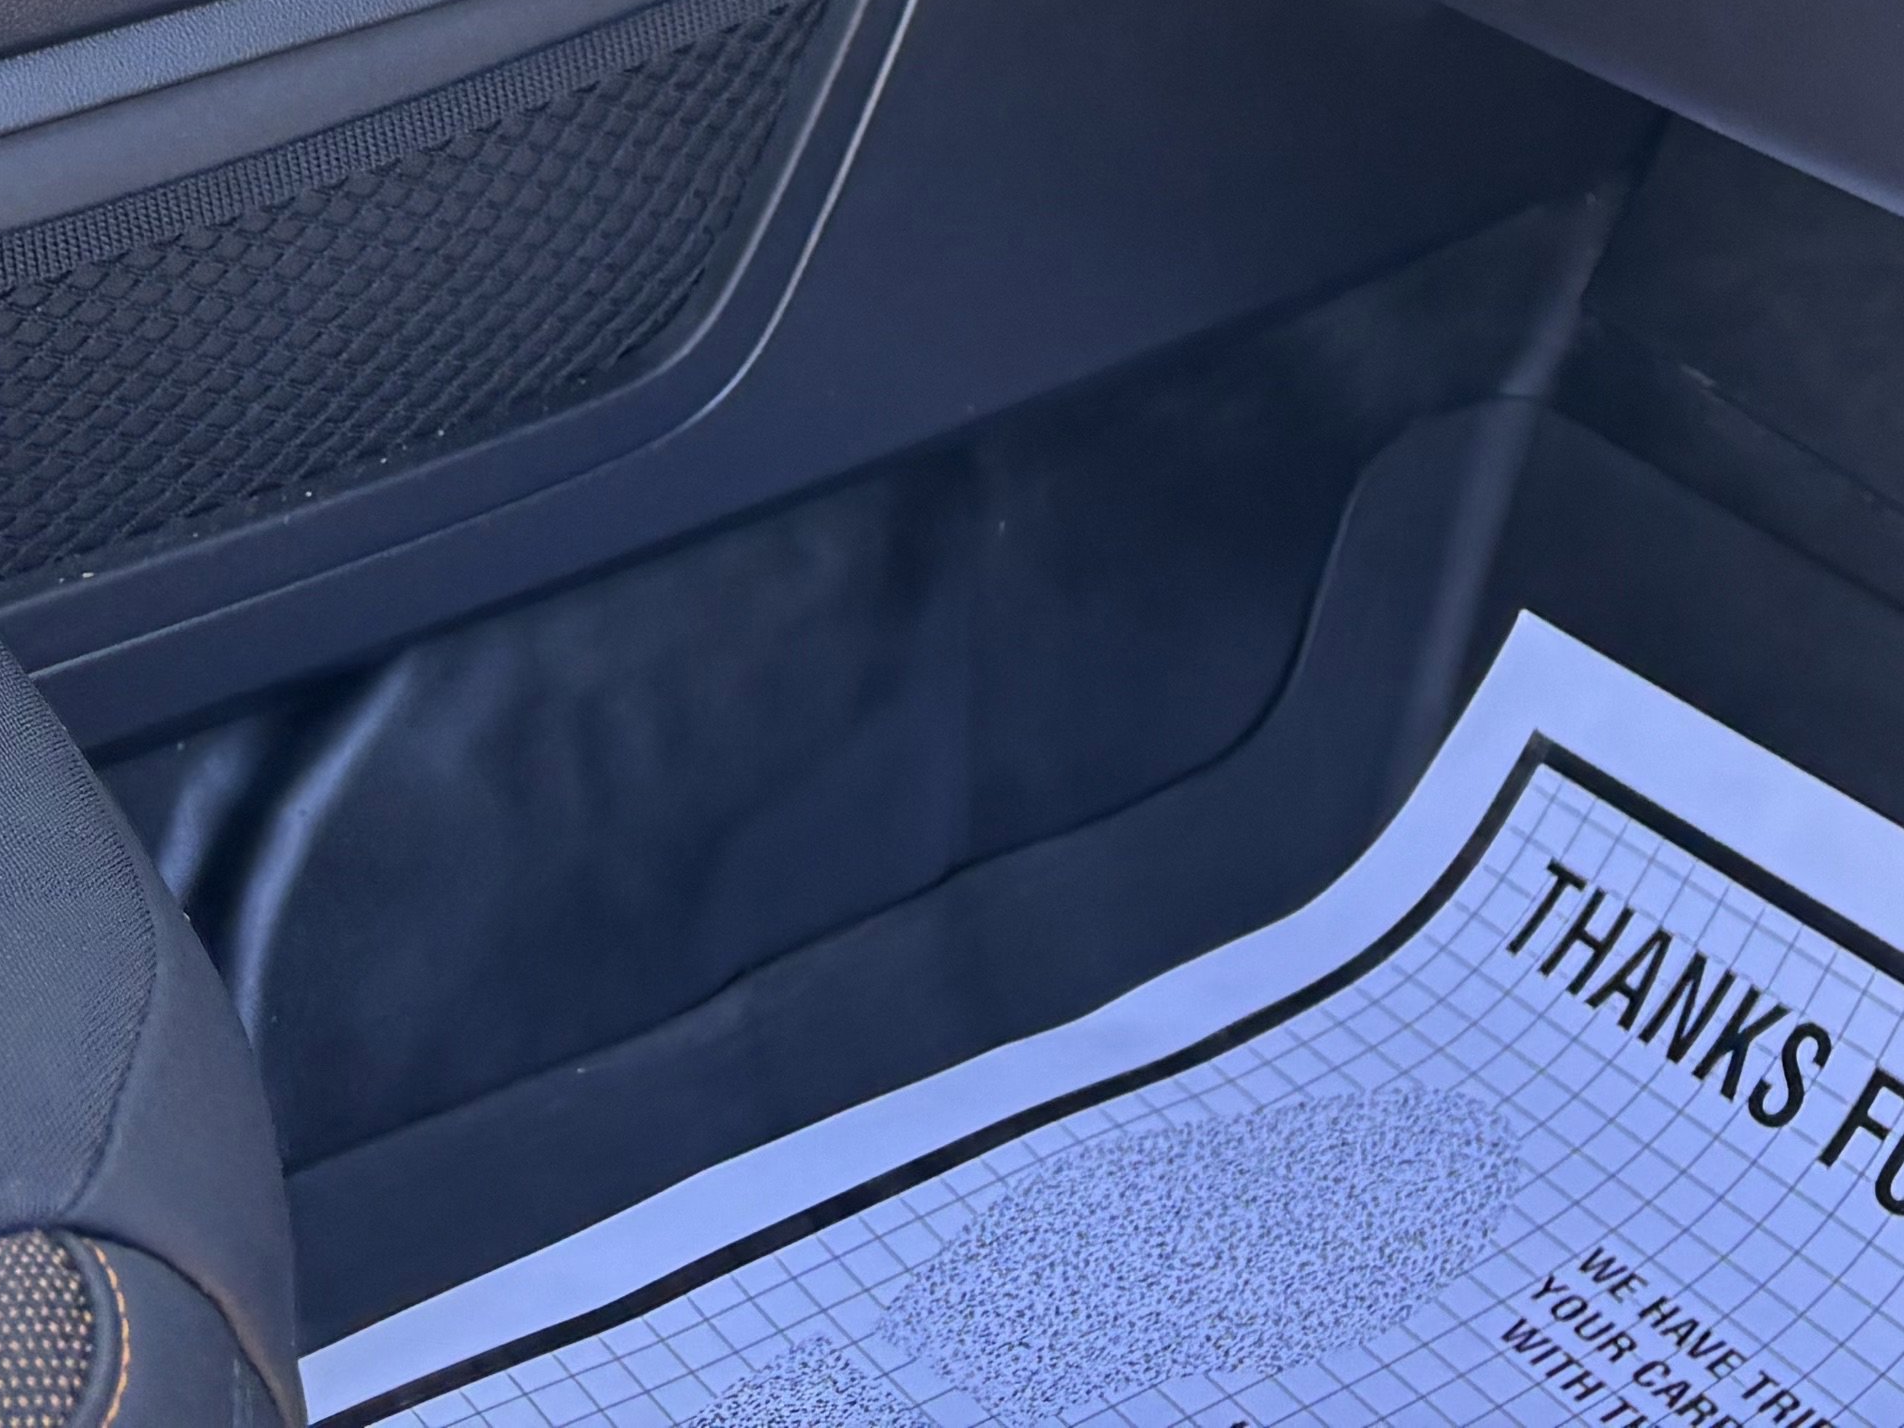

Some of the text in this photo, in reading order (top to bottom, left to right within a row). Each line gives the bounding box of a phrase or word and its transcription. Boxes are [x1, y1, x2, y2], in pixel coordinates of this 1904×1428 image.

[1504, 857, 1833, 1129] THANKS
[1500, 1317, 1607, 1402] WITH
[1531, 1274, 1639, 1363] YOUR
[1578, 1247, 1649, 1304] WE
[1637, 1295, 1749, 1381] HAVE
